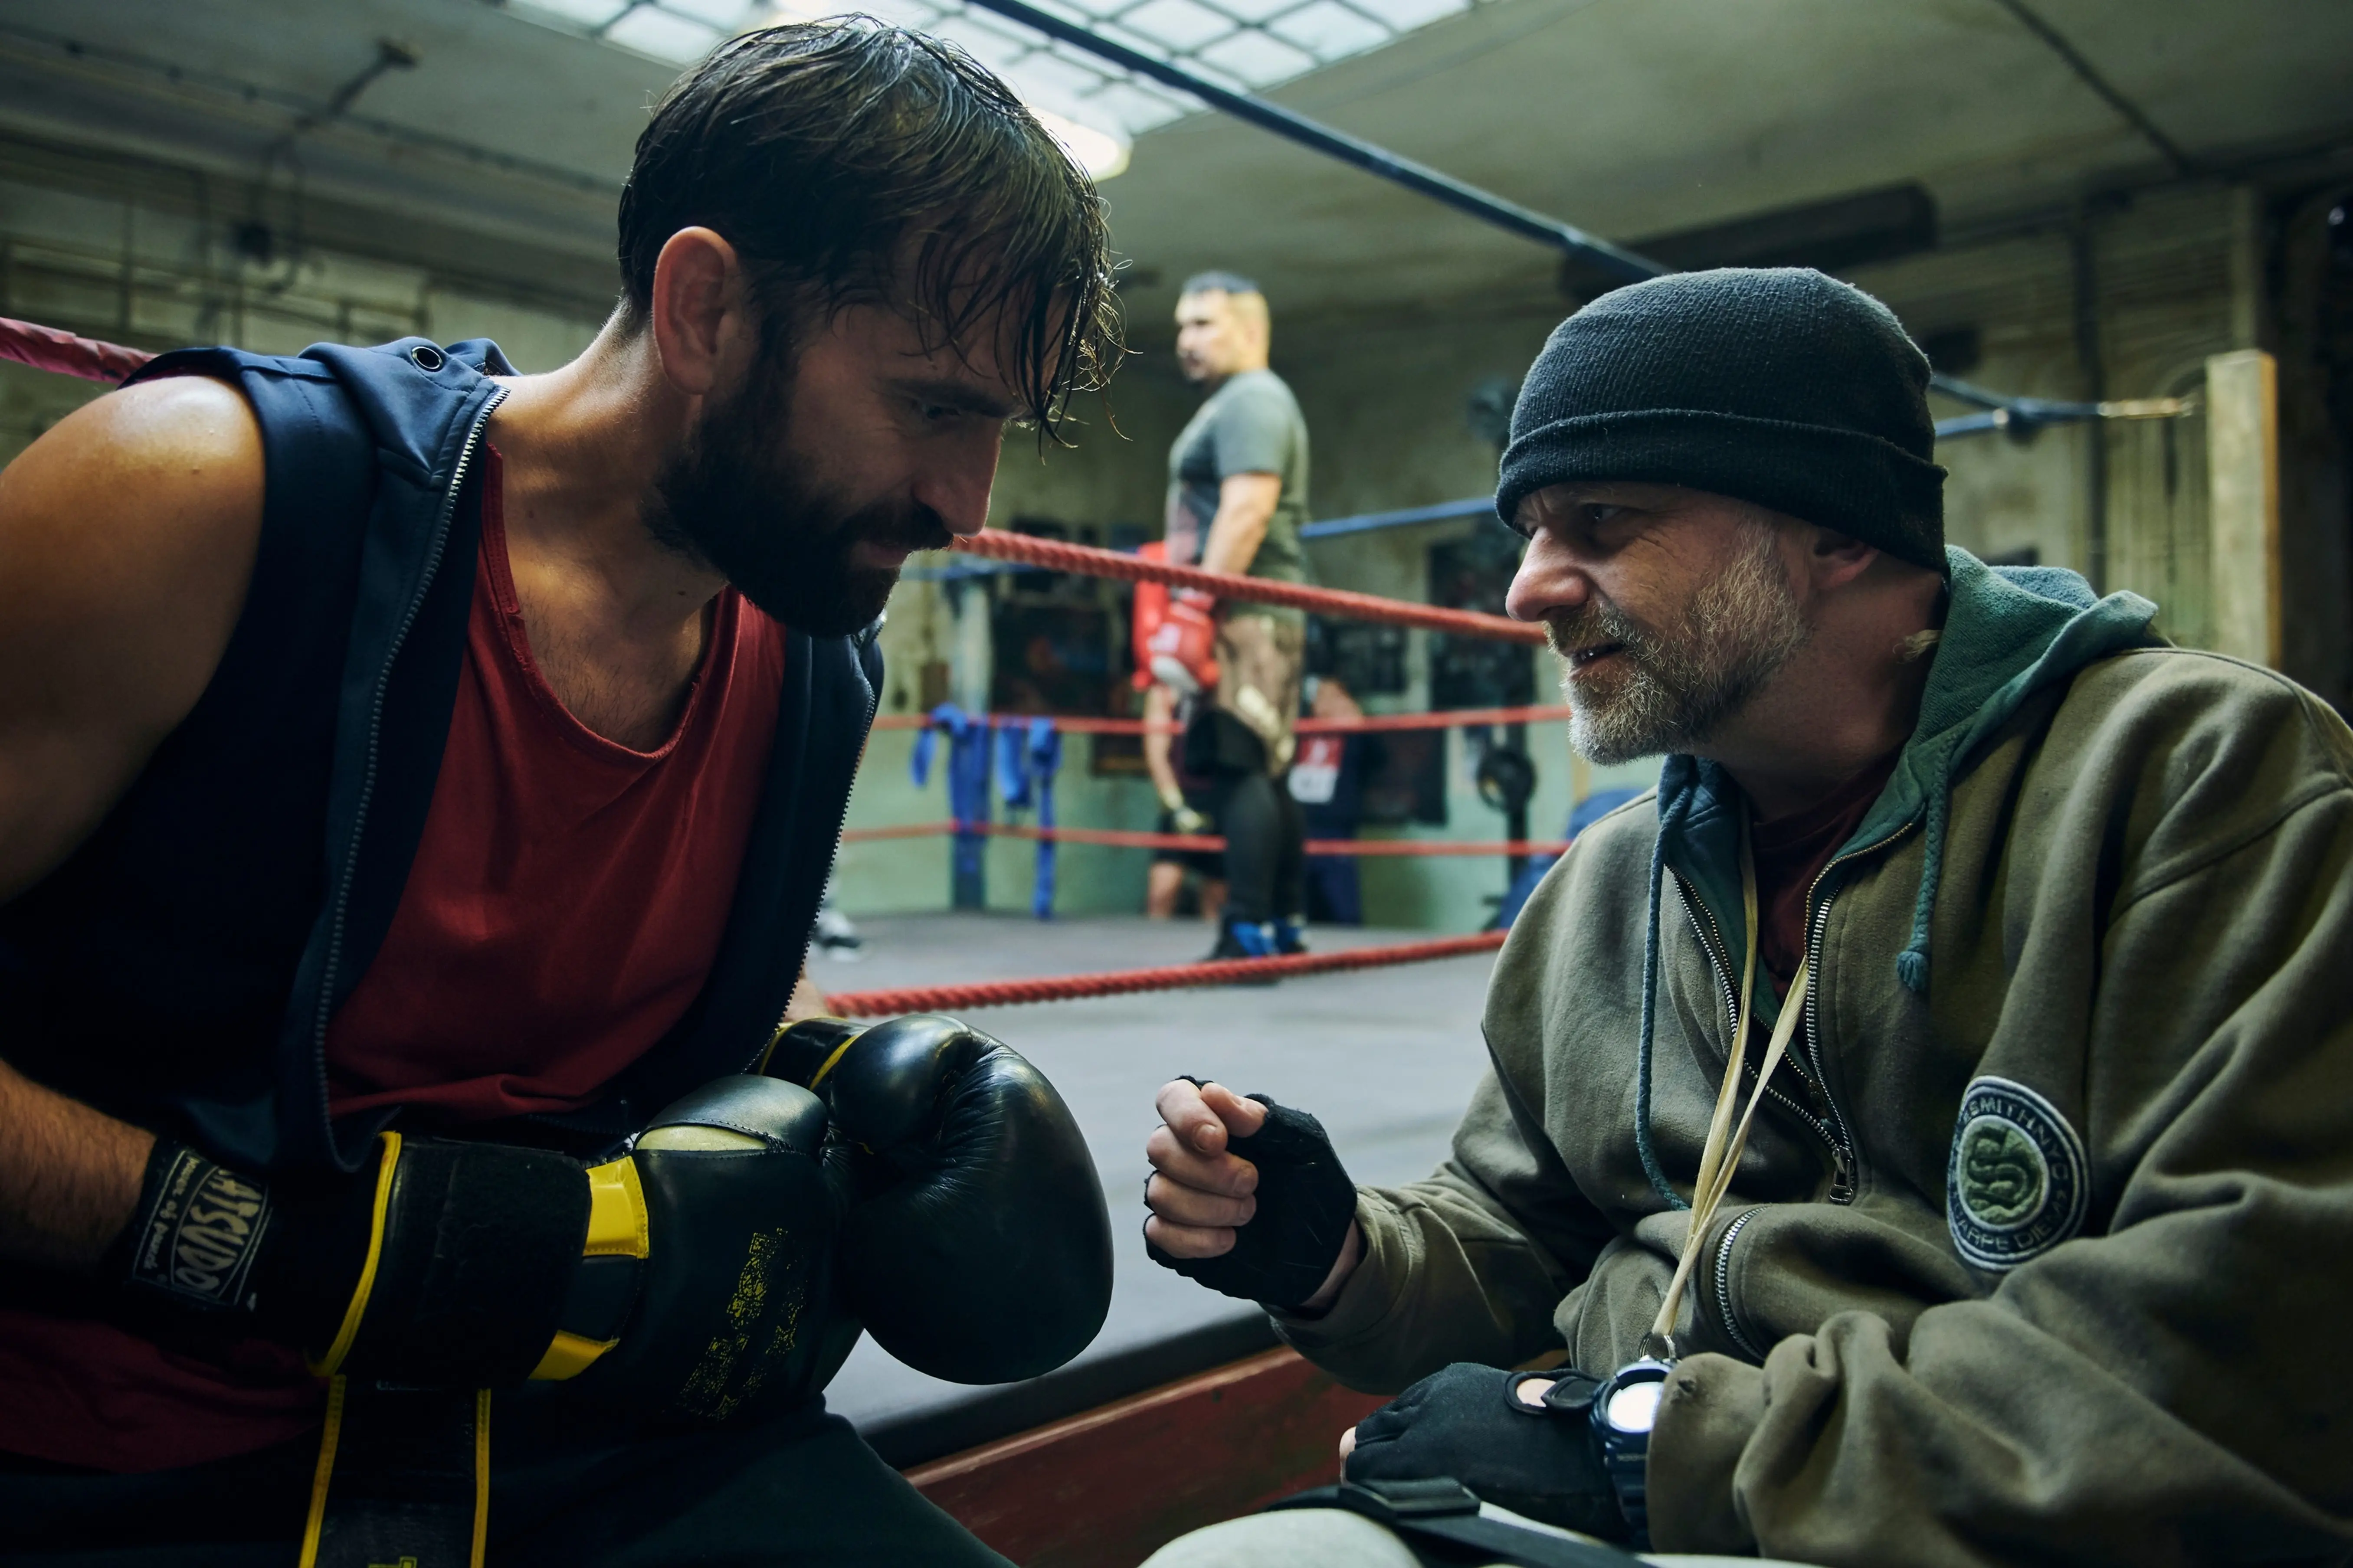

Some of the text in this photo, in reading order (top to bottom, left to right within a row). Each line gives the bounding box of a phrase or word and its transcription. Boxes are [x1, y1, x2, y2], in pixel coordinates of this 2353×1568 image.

[176, 1170, 262, 1291] ATSUDO
[1953, 1201, 2065, 1251] CARPE DIEM
